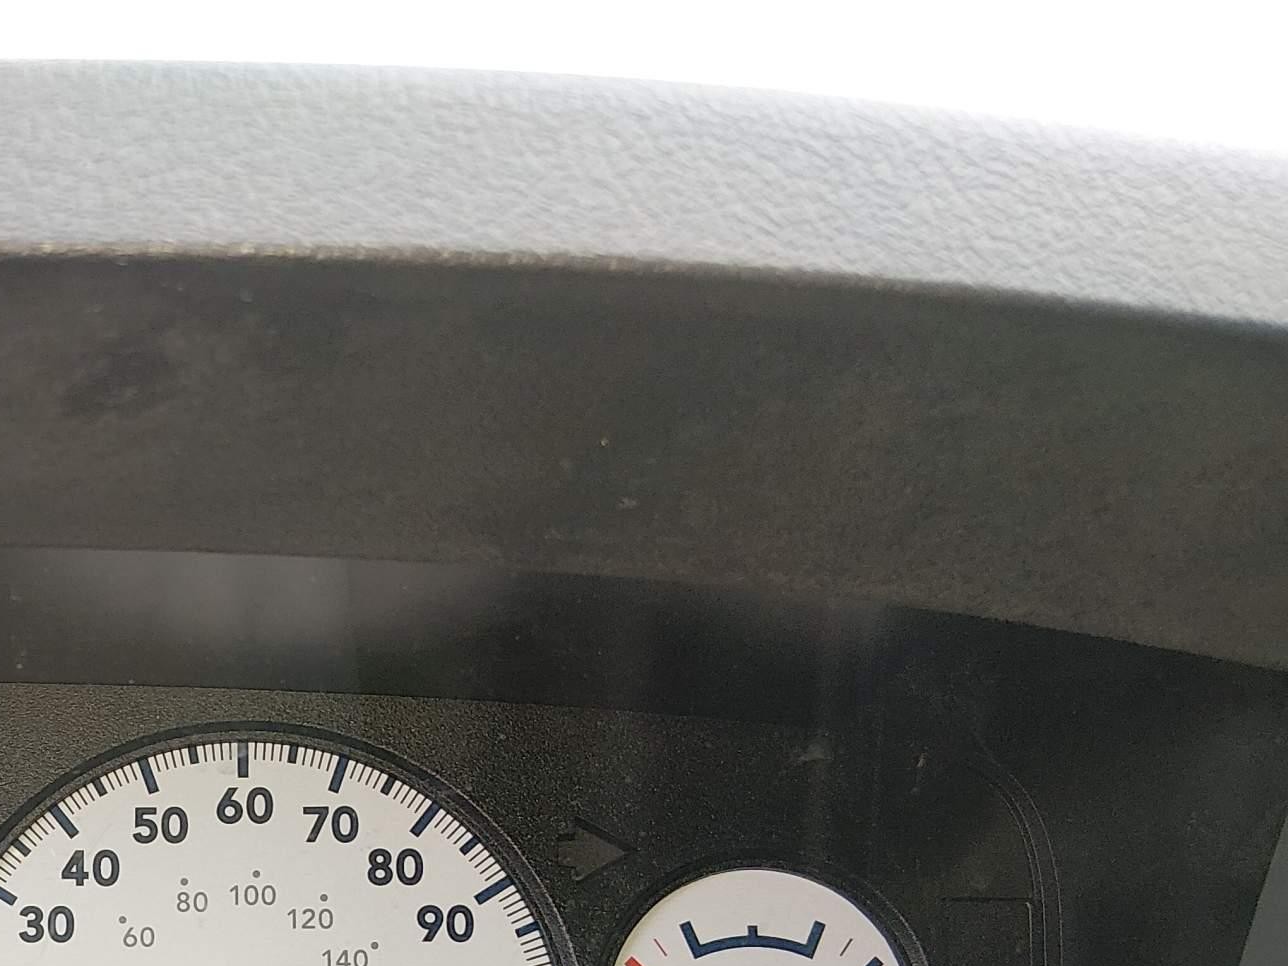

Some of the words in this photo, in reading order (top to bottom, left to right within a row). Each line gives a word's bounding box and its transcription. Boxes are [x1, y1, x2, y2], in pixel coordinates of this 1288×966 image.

[217, 787, 273, 824] 60
[133, 807, 188, 843] 50
[303, 806, 358, 843] 70
[62, 850, 119, 886] 40
[368, 849, 423, 886] 80
[177, 892, 207, 912] 80
[230, 885, 276, 905] 100
[19, 906, 74, 943] 30
[123, 927, 154, 947] 60
[288, 909, 333, 929] 120
[417, 905, 474, 942] 90
